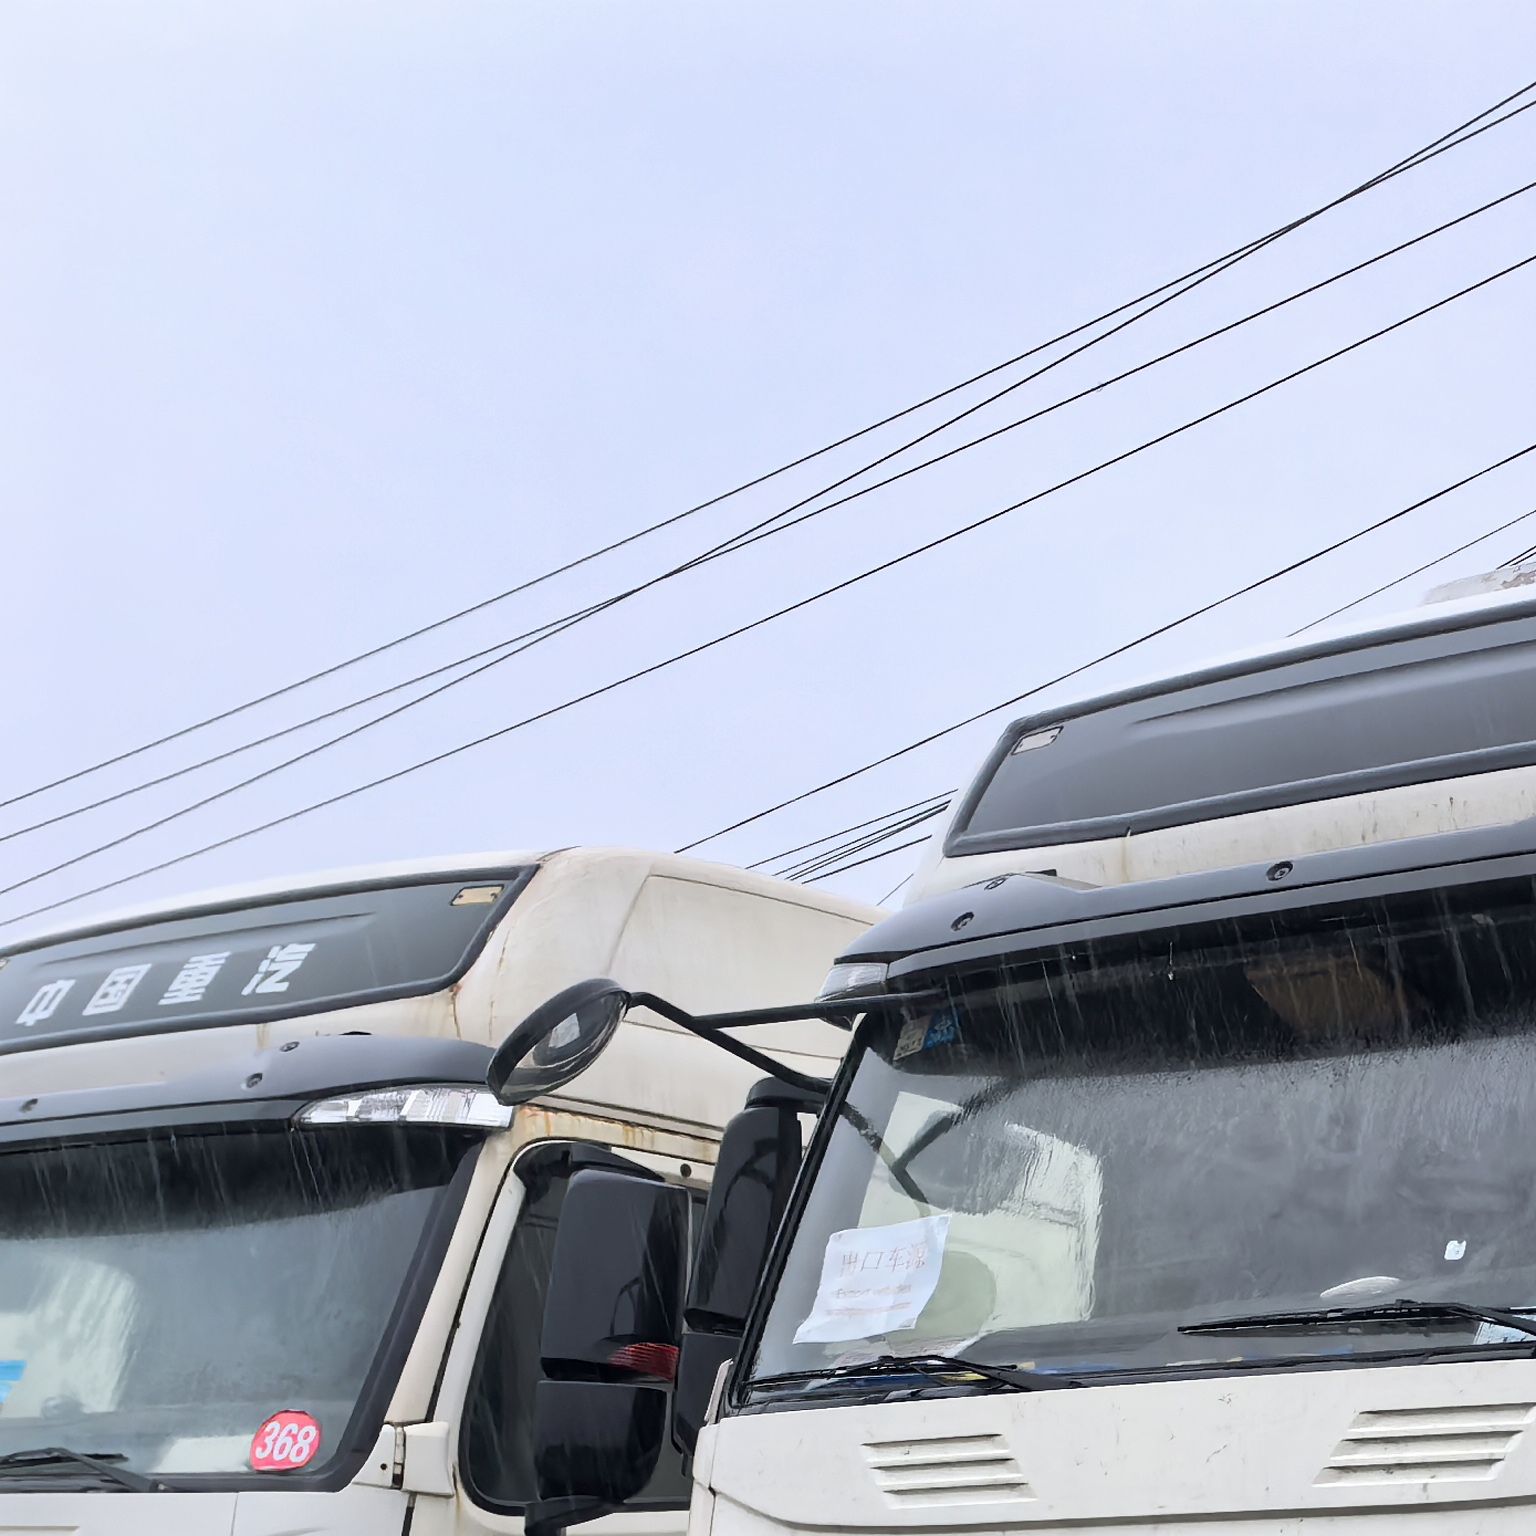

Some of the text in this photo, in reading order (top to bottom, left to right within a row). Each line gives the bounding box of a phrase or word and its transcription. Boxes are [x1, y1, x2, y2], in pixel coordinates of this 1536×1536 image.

[15, 943, 317, 1026] 中国重汽
[255, 1421, 317, 1463] 368
